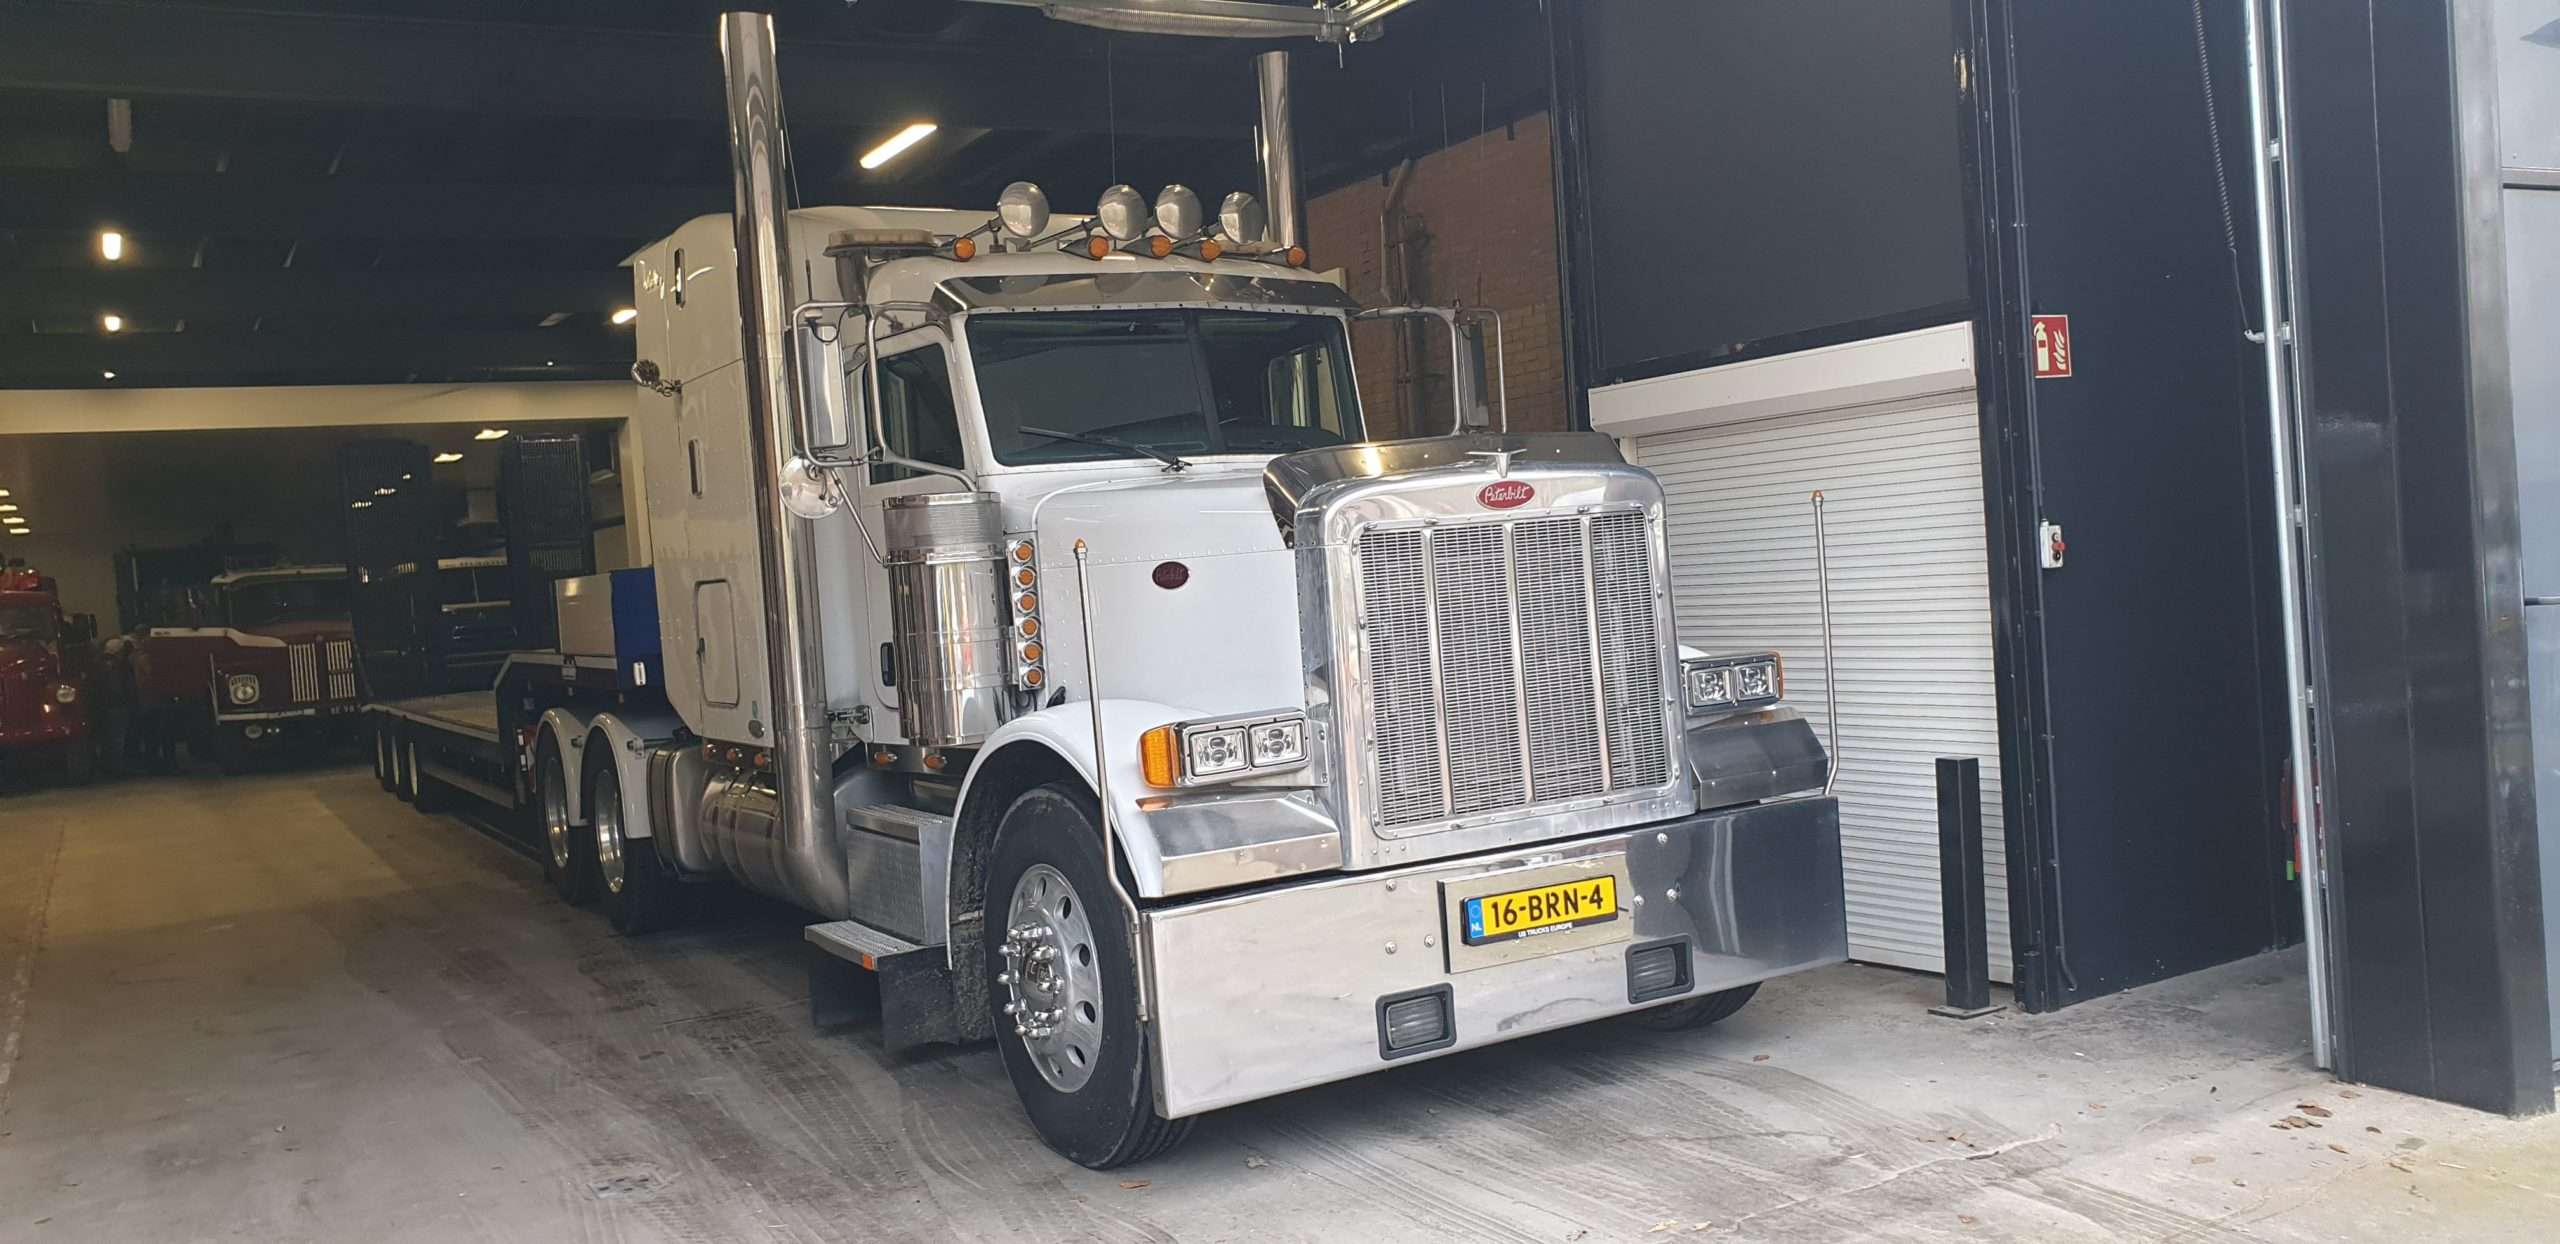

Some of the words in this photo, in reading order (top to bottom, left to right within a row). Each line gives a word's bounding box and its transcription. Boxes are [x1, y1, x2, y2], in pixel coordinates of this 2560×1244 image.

[1484, 485, 1530, 504] Peterbilt
[1490, 884, 1603, 929] 16-BRN-4
[1471, 922, 1482, 932] NL
